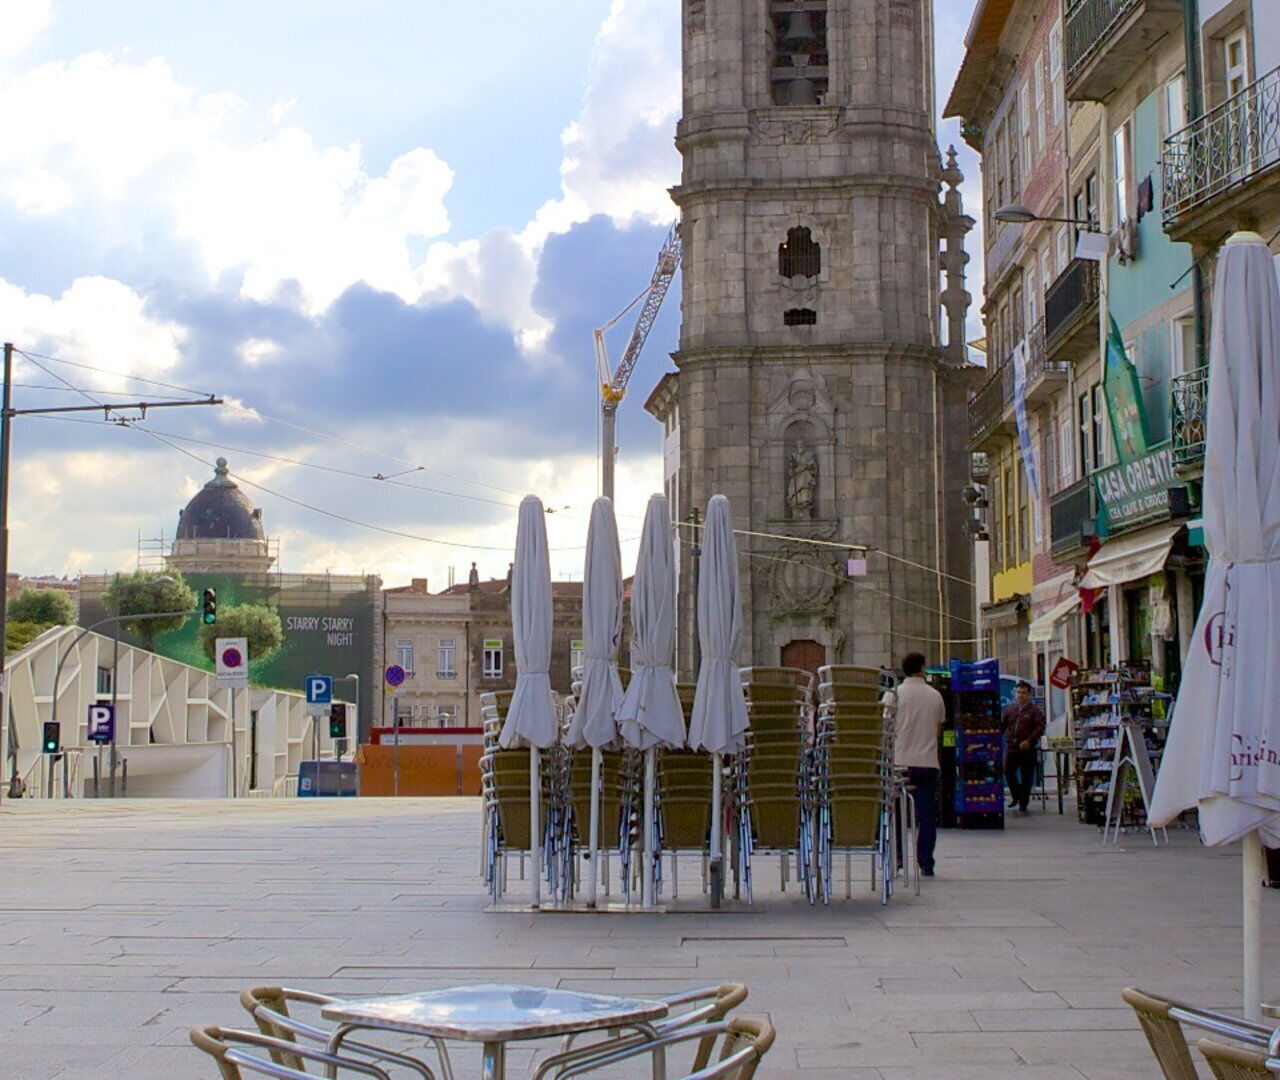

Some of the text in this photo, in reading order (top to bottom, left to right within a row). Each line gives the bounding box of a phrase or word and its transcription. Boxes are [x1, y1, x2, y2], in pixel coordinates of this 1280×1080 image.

[1097, 469, 1129, 503] CASA
[287, 616, 354, 631] STARRY STARRY
[327, 633, 353, 646] NIGHT
[311, 679, 327, 702] P
[91, 706, 111, 733] P
